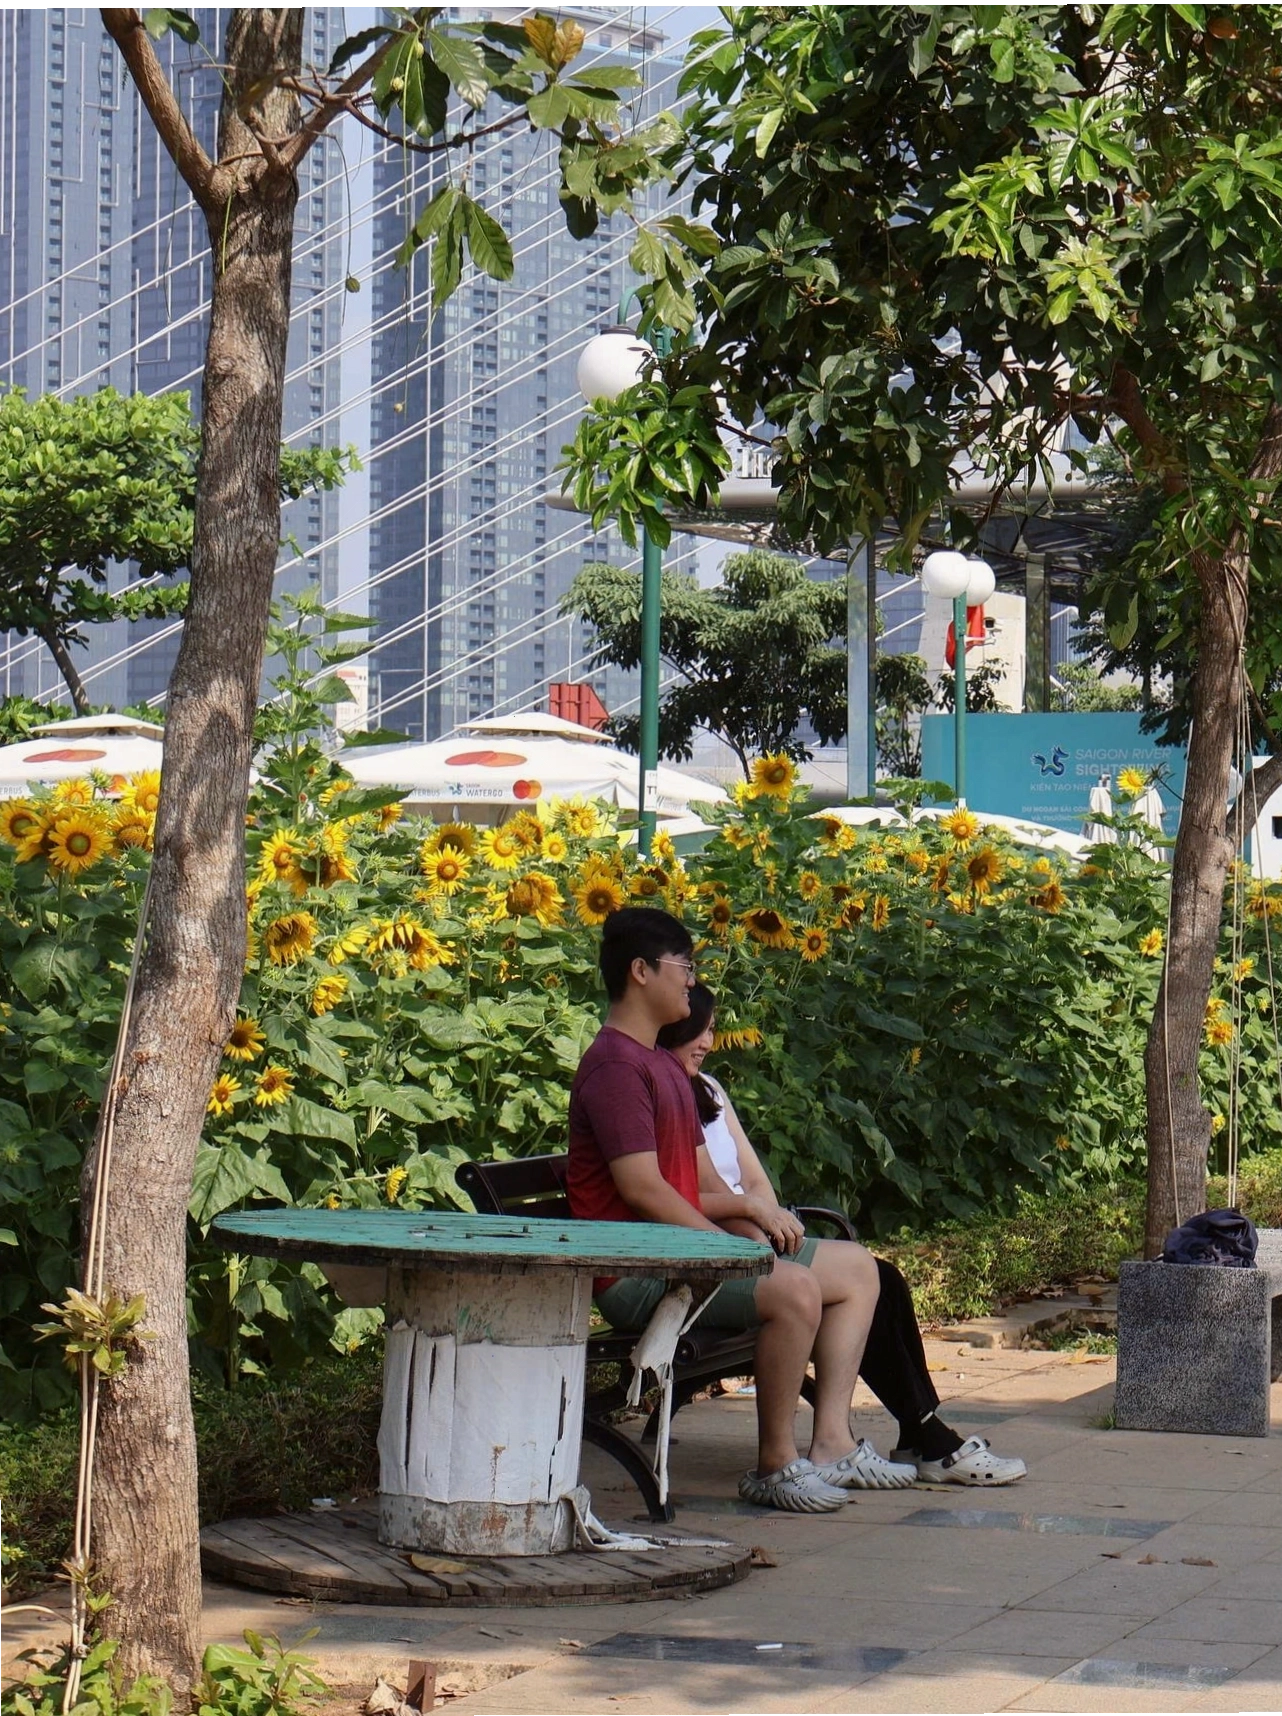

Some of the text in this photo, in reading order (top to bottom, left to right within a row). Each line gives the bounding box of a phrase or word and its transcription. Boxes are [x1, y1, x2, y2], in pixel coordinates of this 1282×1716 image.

[1075, 748, 1172, 760] SAIGON RIVER
[466, 789, 503, 797] WATERGO
